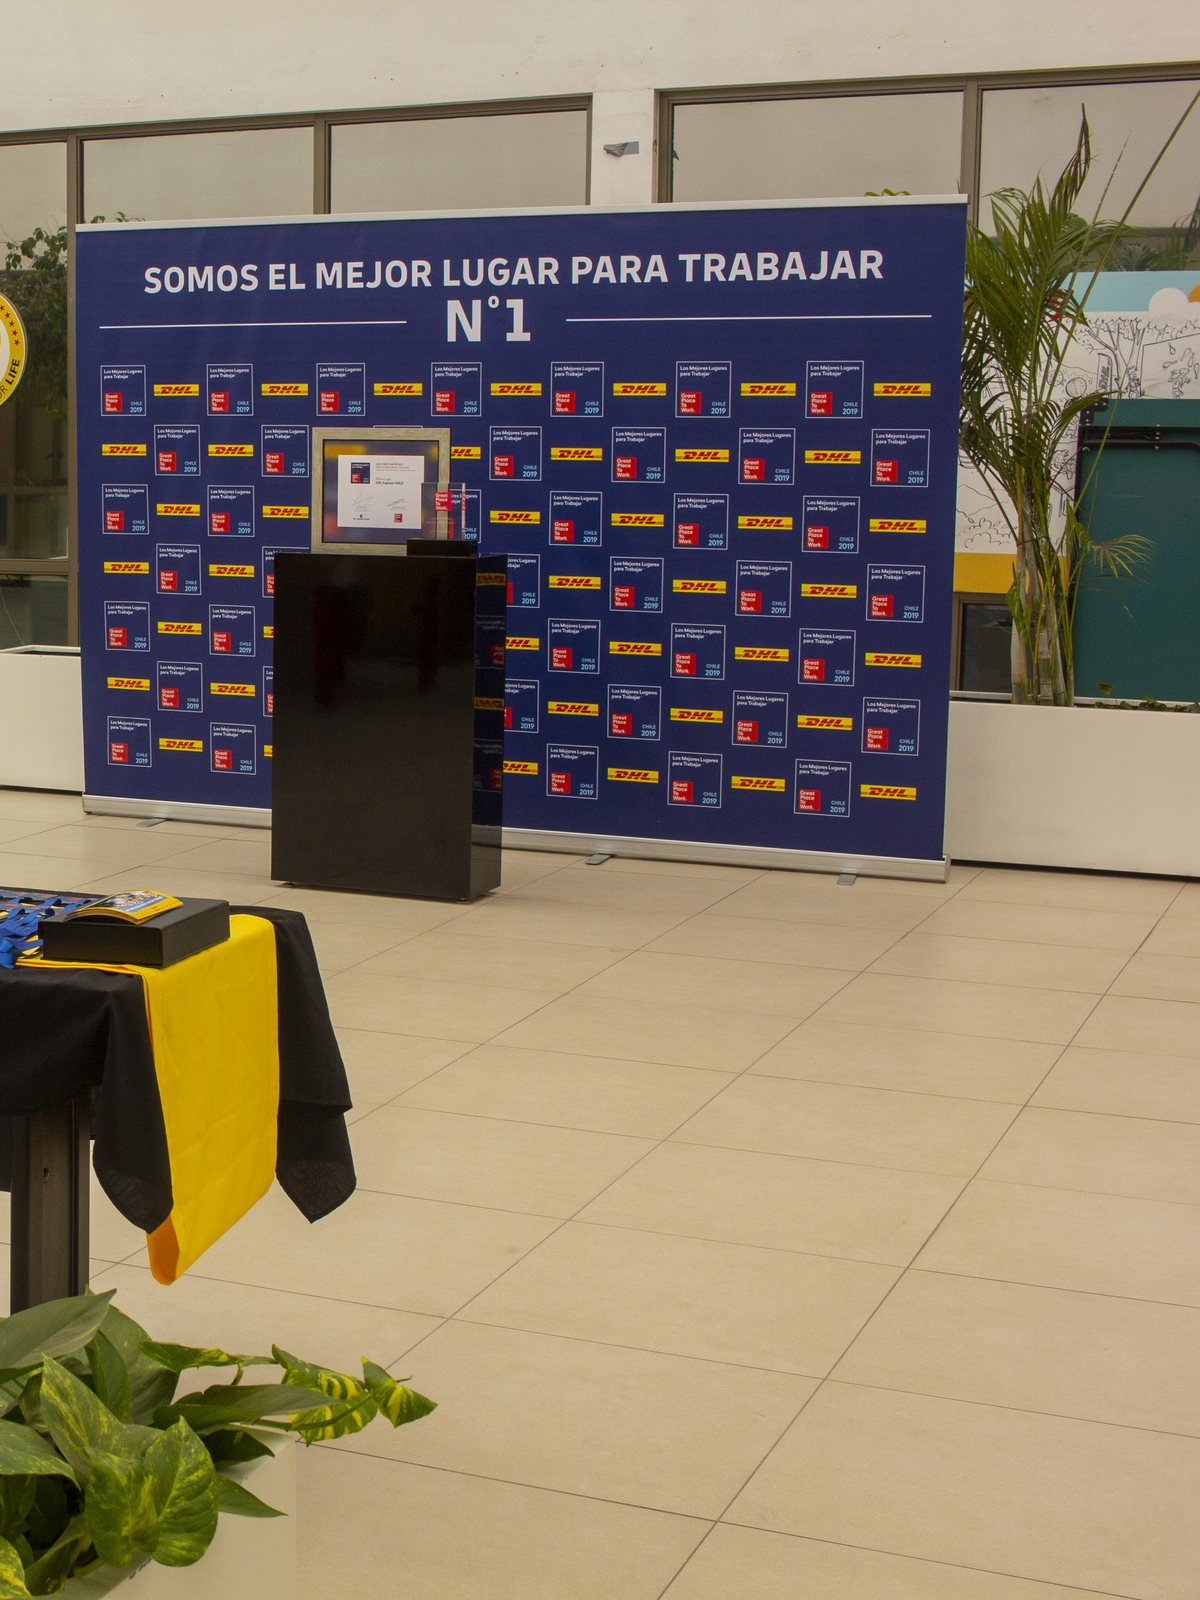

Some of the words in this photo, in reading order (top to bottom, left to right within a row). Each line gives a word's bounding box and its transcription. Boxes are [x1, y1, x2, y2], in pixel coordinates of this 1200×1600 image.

[144, 264, 259, 294] SOMOS
[269, 263, 305, 290] EL
[316, 260, 432, 289] MEJOR
[443, 257, 559, 287] LUGAR
[571, 255, 668, 284] PARA
[679, 250, 884, 282] TRABAJAR
[6, 358, 21, 386] LIFE
[160, 386, 193, 394] DHL
[380, 385, 416, 393] DHL
[498, 385, 535, 393] DHL
[620, 385, 659, 394] DHL
[748, 385, 789, 394] DHL
[881, 385, 924, 394] DHL
[108, 446, 140, 454] DHL
[214, 446, 248, 454] DHL
[451, 448, 473, 457] HL
[558, 450, 595, 458] DHL
[683, 451, 722, 460] DHL
[812, 452, 854, 462] DHL
[163, 506, 194, 514] DHL
[269, 508, 303, 516] DHL
[496, 513, 534, 522] DHL
[619, 515, 657, 524] DHL
[745, 518, 785, 528] DHL
[877, 521, 919, 531] DHL
[110, 564, 143, 572] DHL
[215, 566, 248, 575] DHL
[556, 578, 594, 587] DHL
[680, 582, 719, 591] DHL
[808, 586, 850, 596] DHL
[164, 624, 195, 632] DHL
[617, 644, 655, 654] DHL
[742, 649, 782, 659] DHL
[872, 655, 915, 665] DHL
[113, 679, 145, 688] DHL
[217, 685, 250, 694] DHL
[554, 704, 592, 714] DHL
[678, 710, 716, 721] DHL
[805, 717, 846, 728] DHL
[165, 740, 197, 750] DHL
[614, 770, 652, 781] DHL
[739, 778, 778, 789] DHL
[868, 786, 910, 798] DHL
